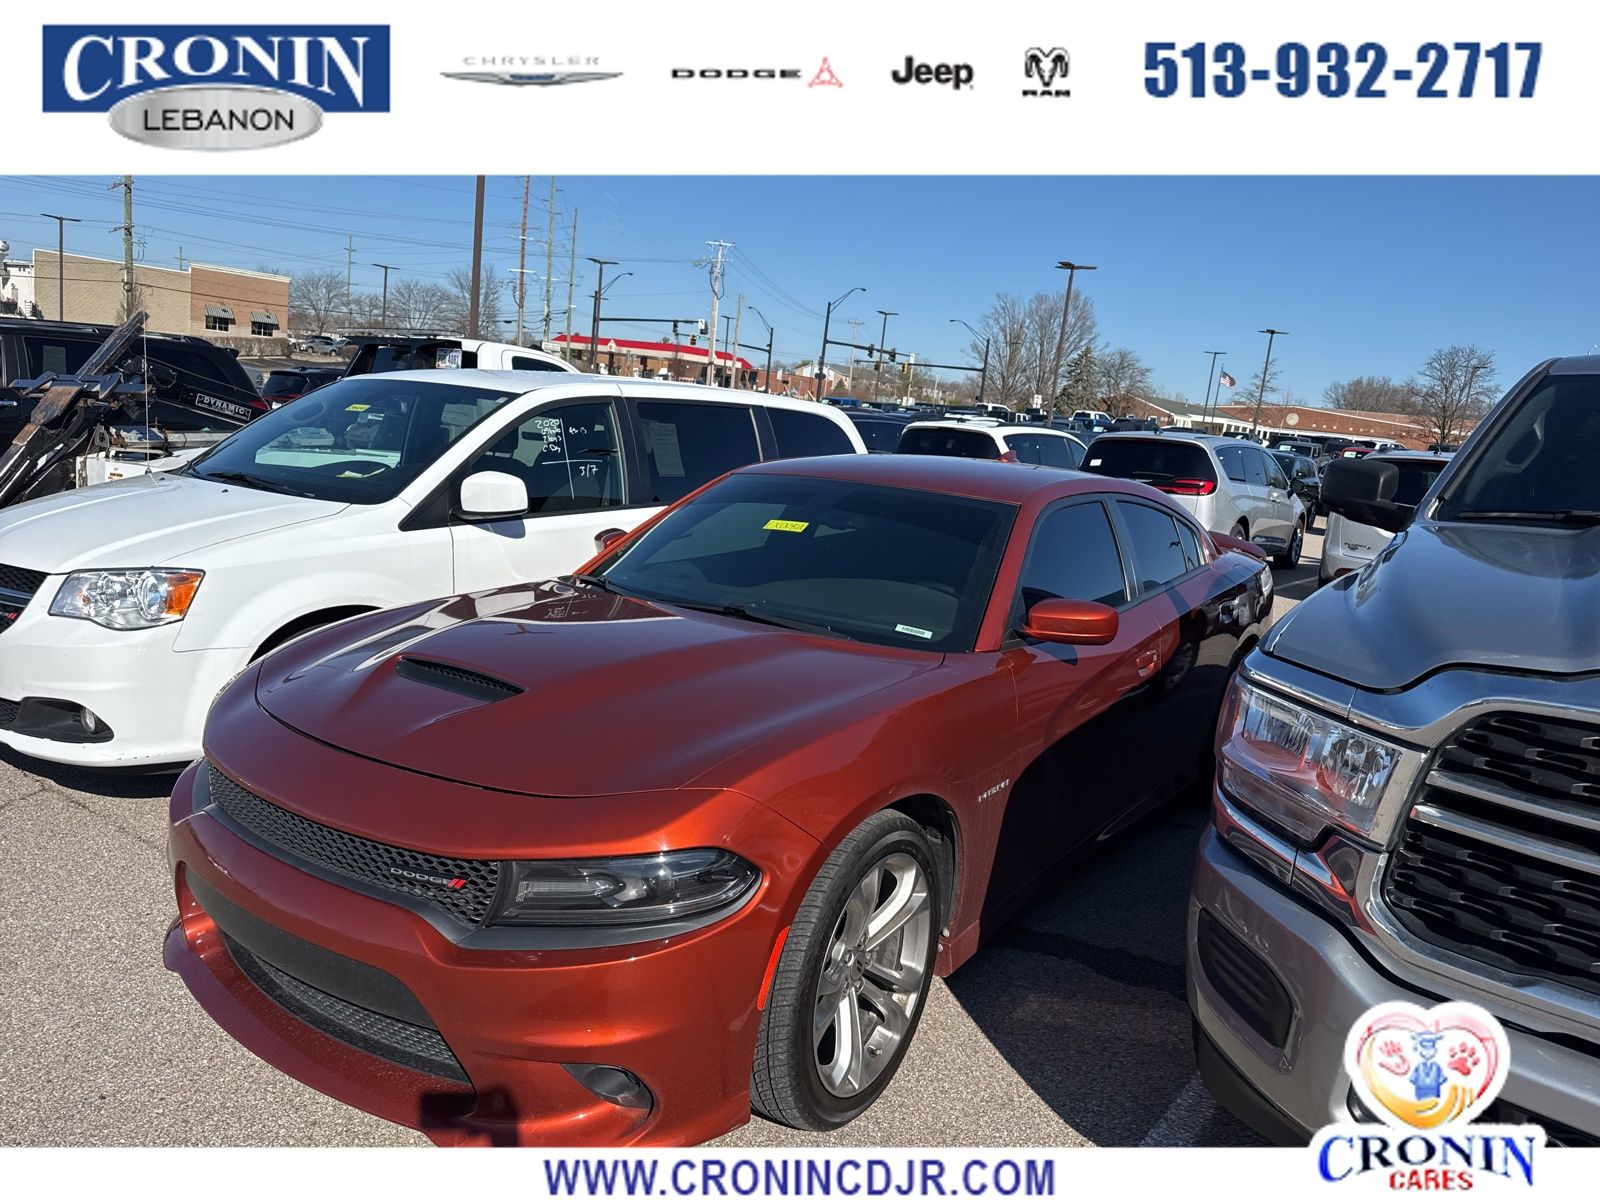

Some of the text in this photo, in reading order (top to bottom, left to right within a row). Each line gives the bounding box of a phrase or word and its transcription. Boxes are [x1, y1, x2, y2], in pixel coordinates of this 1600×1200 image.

[203, 397, 245, 414] DYNAMIC
[579, 464, 598, 478] 3/7
[390, 867, 450, 885] DODGE
